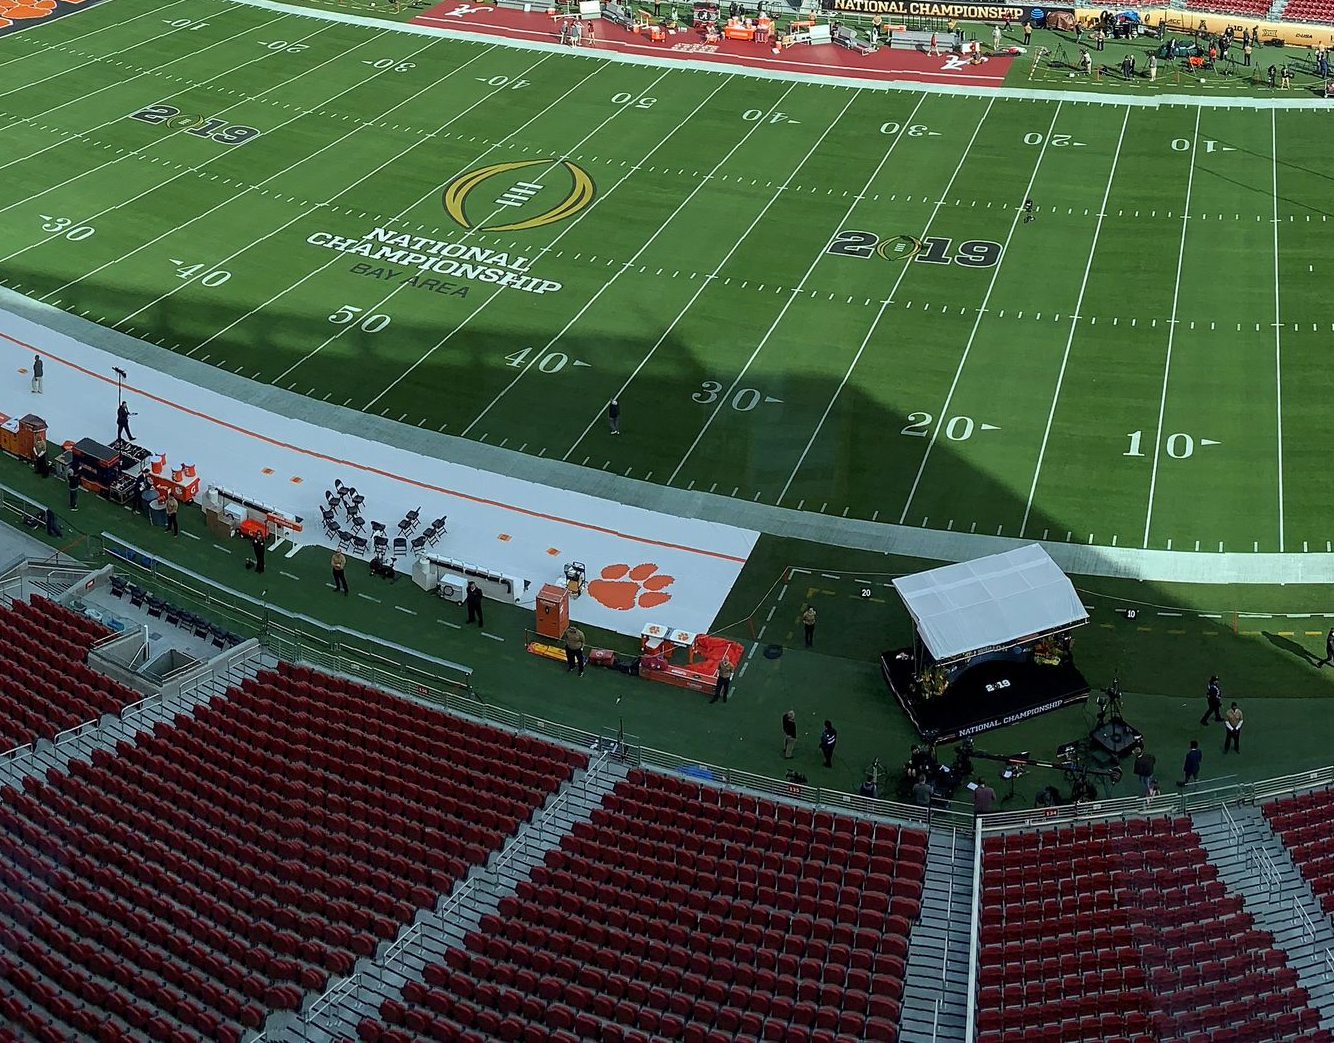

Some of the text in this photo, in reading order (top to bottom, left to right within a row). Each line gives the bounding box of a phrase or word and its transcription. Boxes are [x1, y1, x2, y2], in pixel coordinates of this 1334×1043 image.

[909, 3, 1024, 20] CHAMPIONSHIP
[41, 217, 96, 242] 30
[306, 231, 563, 295] CHAMPIONSHIP
[362, 227, 531, 273] NATIONAL
[174, 263, 232, 287] 40
[349, 262, 471, 299] BAY AREA
[328, 304, 391, 333] 50
[504, 346, 569, 373] 40
[691, 379, 762, 413] 30
[900, 411, 975, 442] 20
[1121, 430, 1194, 459] 10
[958, 700, 1063, 737] NATIONAL CHAMPIONSHIP
